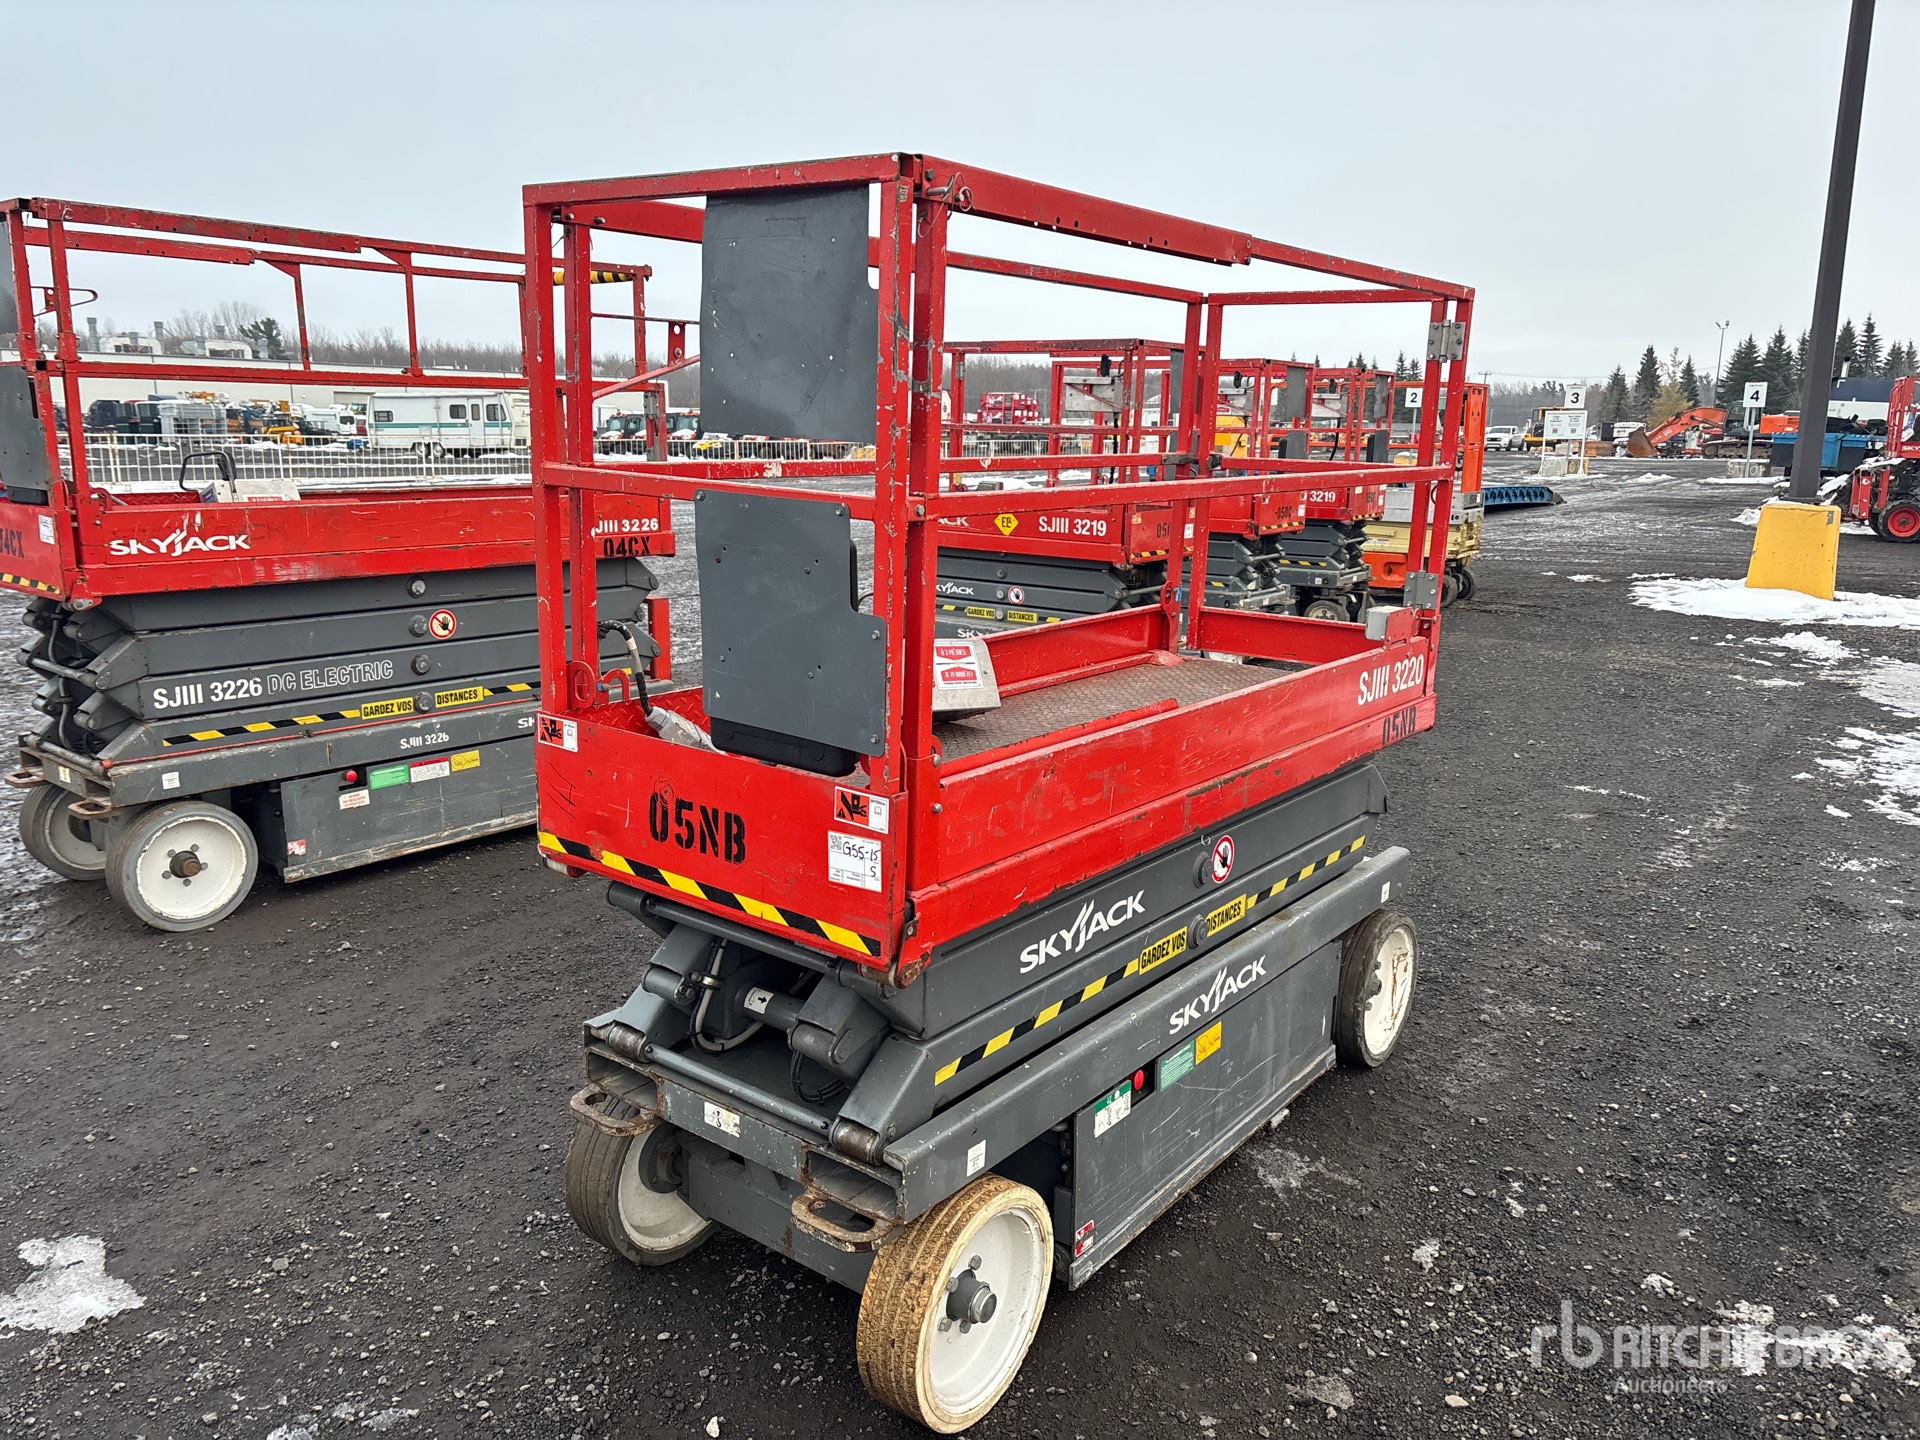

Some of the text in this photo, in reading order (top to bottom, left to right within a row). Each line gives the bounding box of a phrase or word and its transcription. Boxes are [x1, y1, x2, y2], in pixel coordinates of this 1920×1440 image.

[1410, 392, 1418, 403] 2
[1570, 392, 1580, 404] 3
[1749, 389, 1760, 402] 4
[1309, 490, 1336, 503] 3219
[621, 517, 659, 532] 3226
[1039, 516, 1107, 537] SJIII 3219
[109, 528, 251, 557] SKYJACK
[603, 536, 651, 557] 04CX
[967, 608, 986, 616] GARDEZ
[1008, 611, 1034, 621] DISTANCES
[267, 659, 393, 695] DC ELECTRIC
[1357, 653, 1424, 706] SJIII 3220
[153, 678, 262, 709] SJIII 3226
[363, 688, 477, 717] GARDEZ VOS DISTANCES
[424, 732, 449, 745] 3226
[1382, 705, 1416, 745] 05NB
[649, 792, 746, 865] 05NB
[1019, 889, 1146, 974] SKYJACK
[1140, 900, 1242, 970] GARDEZ VOS DISTANCES
[1169, 954, 1267, 1035] SKYJACK
